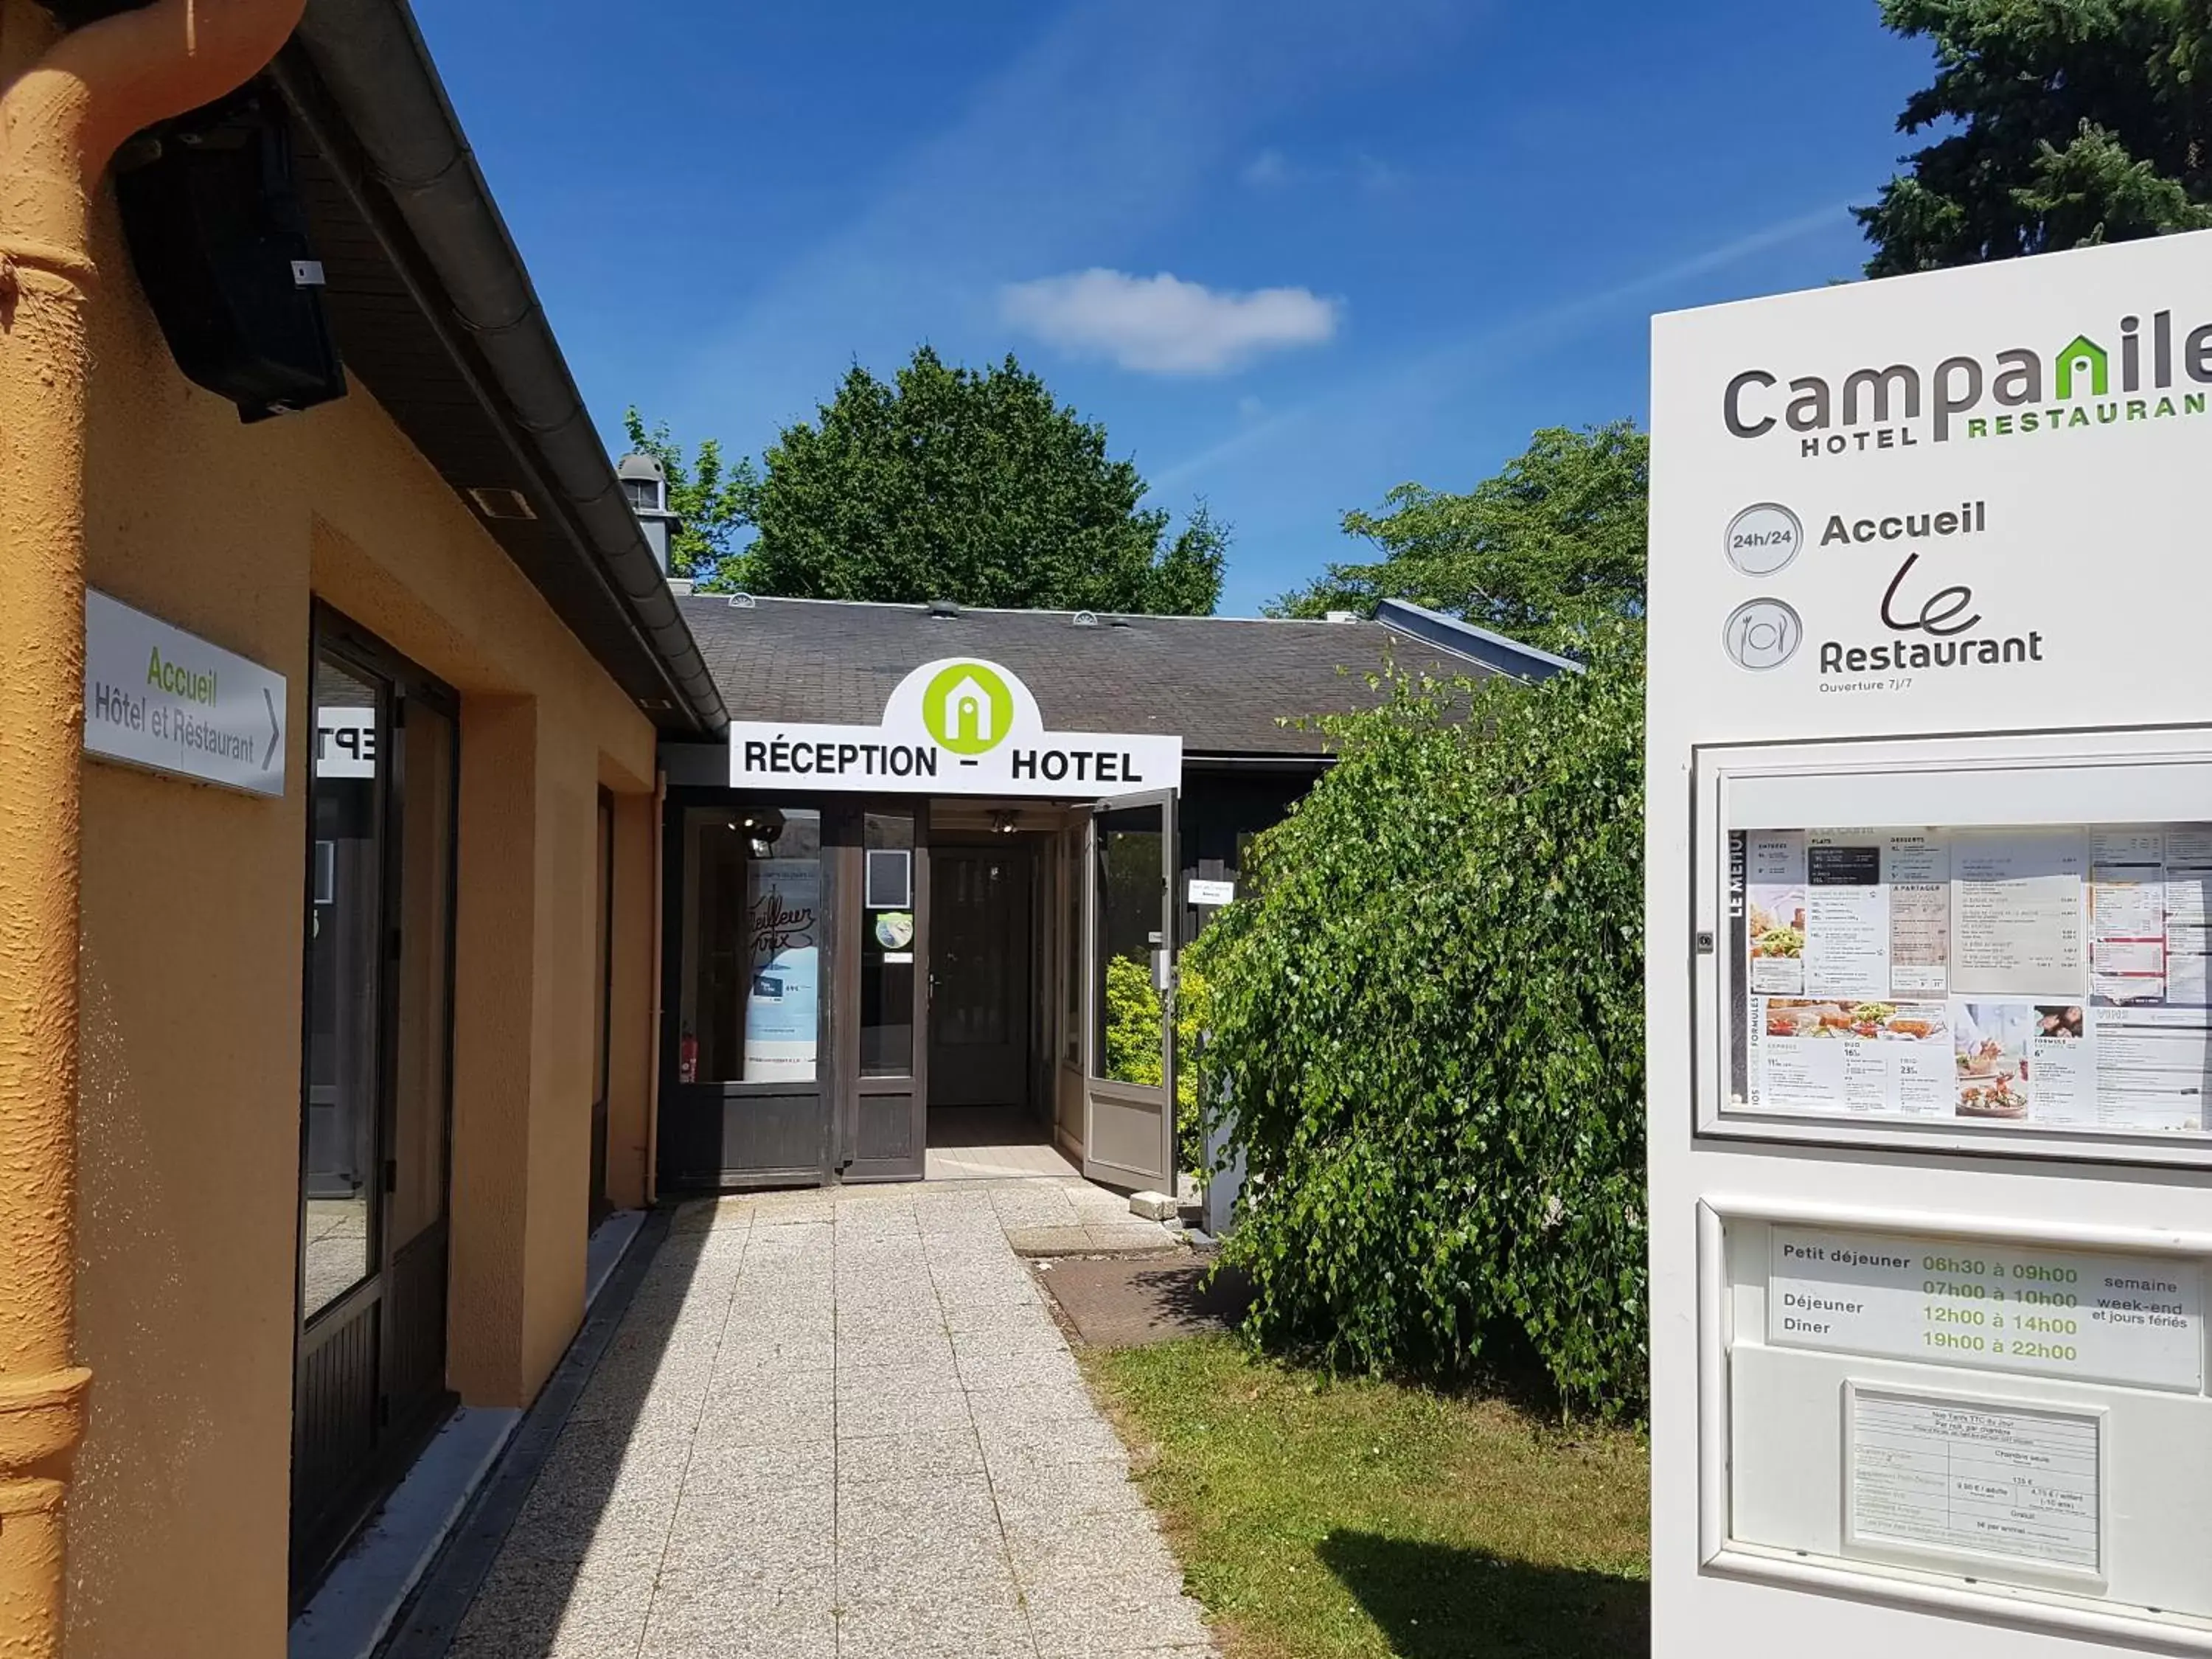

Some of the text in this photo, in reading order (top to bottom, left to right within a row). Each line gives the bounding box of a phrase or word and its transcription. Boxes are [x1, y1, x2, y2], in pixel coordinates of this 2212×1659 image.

[1723, 310, 2212, 442] Campanile
[1801, 392, 2205, 458] HOTEL RESTAURAN
[1733, 531, 1792, 549] 24h/24
[1820, 501, 1985, 546] Accueil
[1880, 552, 1982, 636] Le
[1820, 630, 2043, 675] Restaurant
[147, 646, 218, 708] Accueil
[1819, 678, 1913, 693] Ouverture 7j/7
[95, 681, 145, 732] Hôtel
[151, 706, 168, 740] et
[745, 734, 937, 776] RÉCEPTION
[1012, 749, 1143, 782] HOTEL
[1729, 897, 1743, 917] LE
[1751, 997, 1759, 1046] FORMULES
[1784, 1244, 2177, 1293] Petit déjeuner 06h30 à 09h00 semaine
[1784, 1293, 2077, 1335] Déjeuner 12h00 à 14h00
[1923, 1280, 2183, 1315] 07h00 à 10h00 week-end
[2092, 1310, 2188, 1328] et jours fériés
[1923, 1332, 1985, 1351] 19h00
[1992, 1339, 2004, 1353] à
[2012, 1340, 2077, 1360] 22h00
